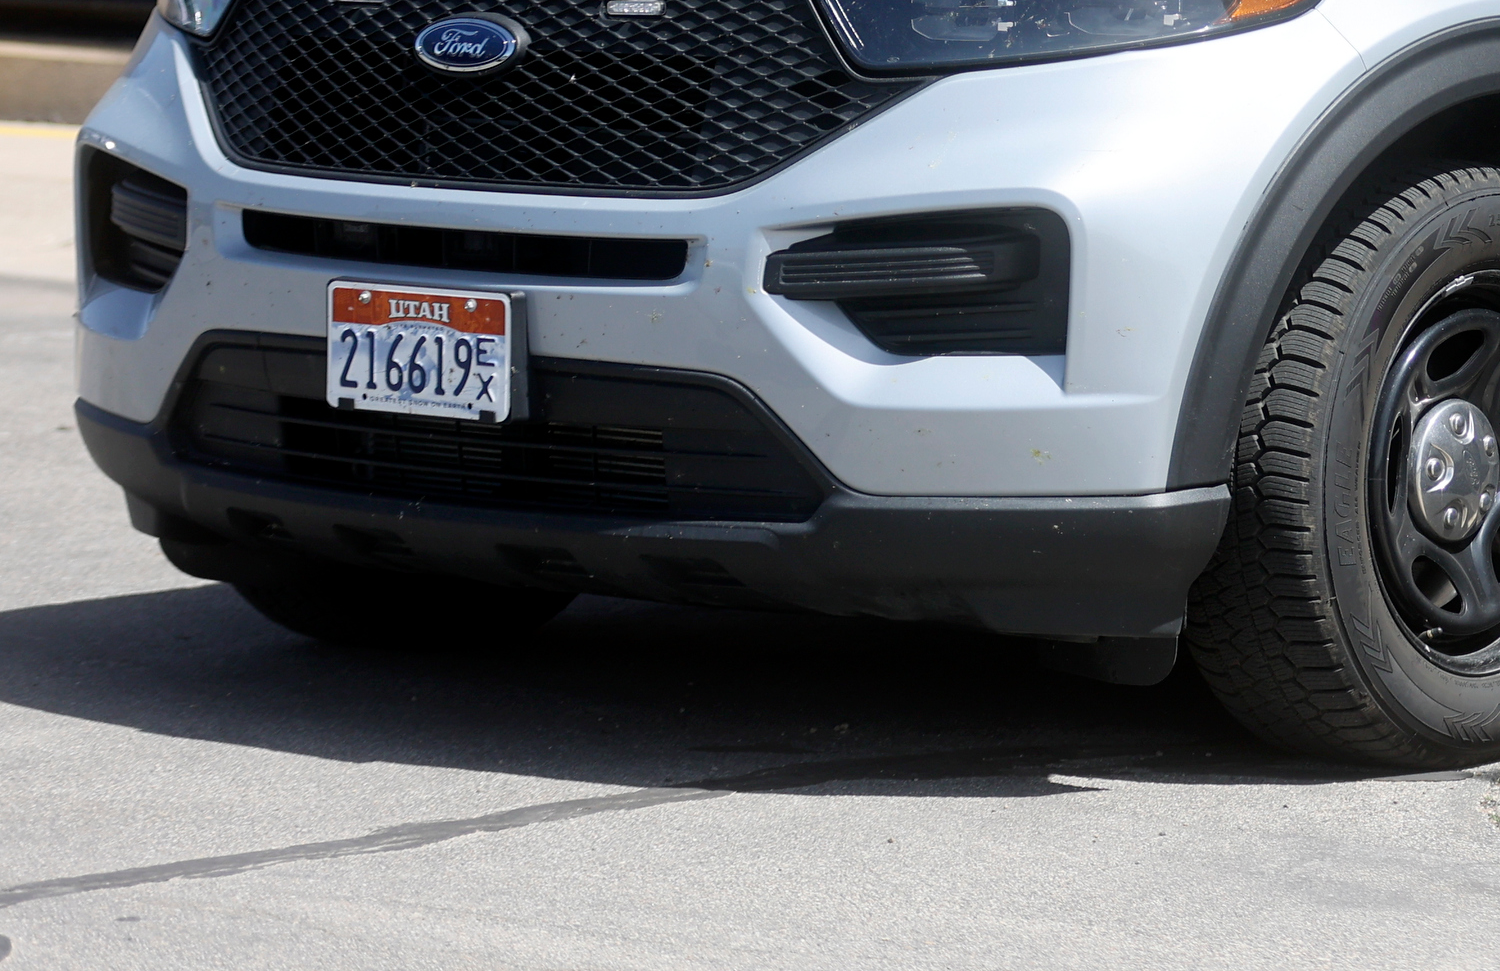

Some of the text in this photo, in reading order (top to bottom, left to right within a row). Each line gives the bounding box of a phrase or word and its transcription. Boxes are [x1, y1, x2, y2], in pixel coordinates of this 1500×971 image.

[433, 29, 490, 57] Ford
[388, 298, 451, 323] UTAH
[340, 328, 472, 397] 216619
[1333, 440, 1357, 567] EAGLE
